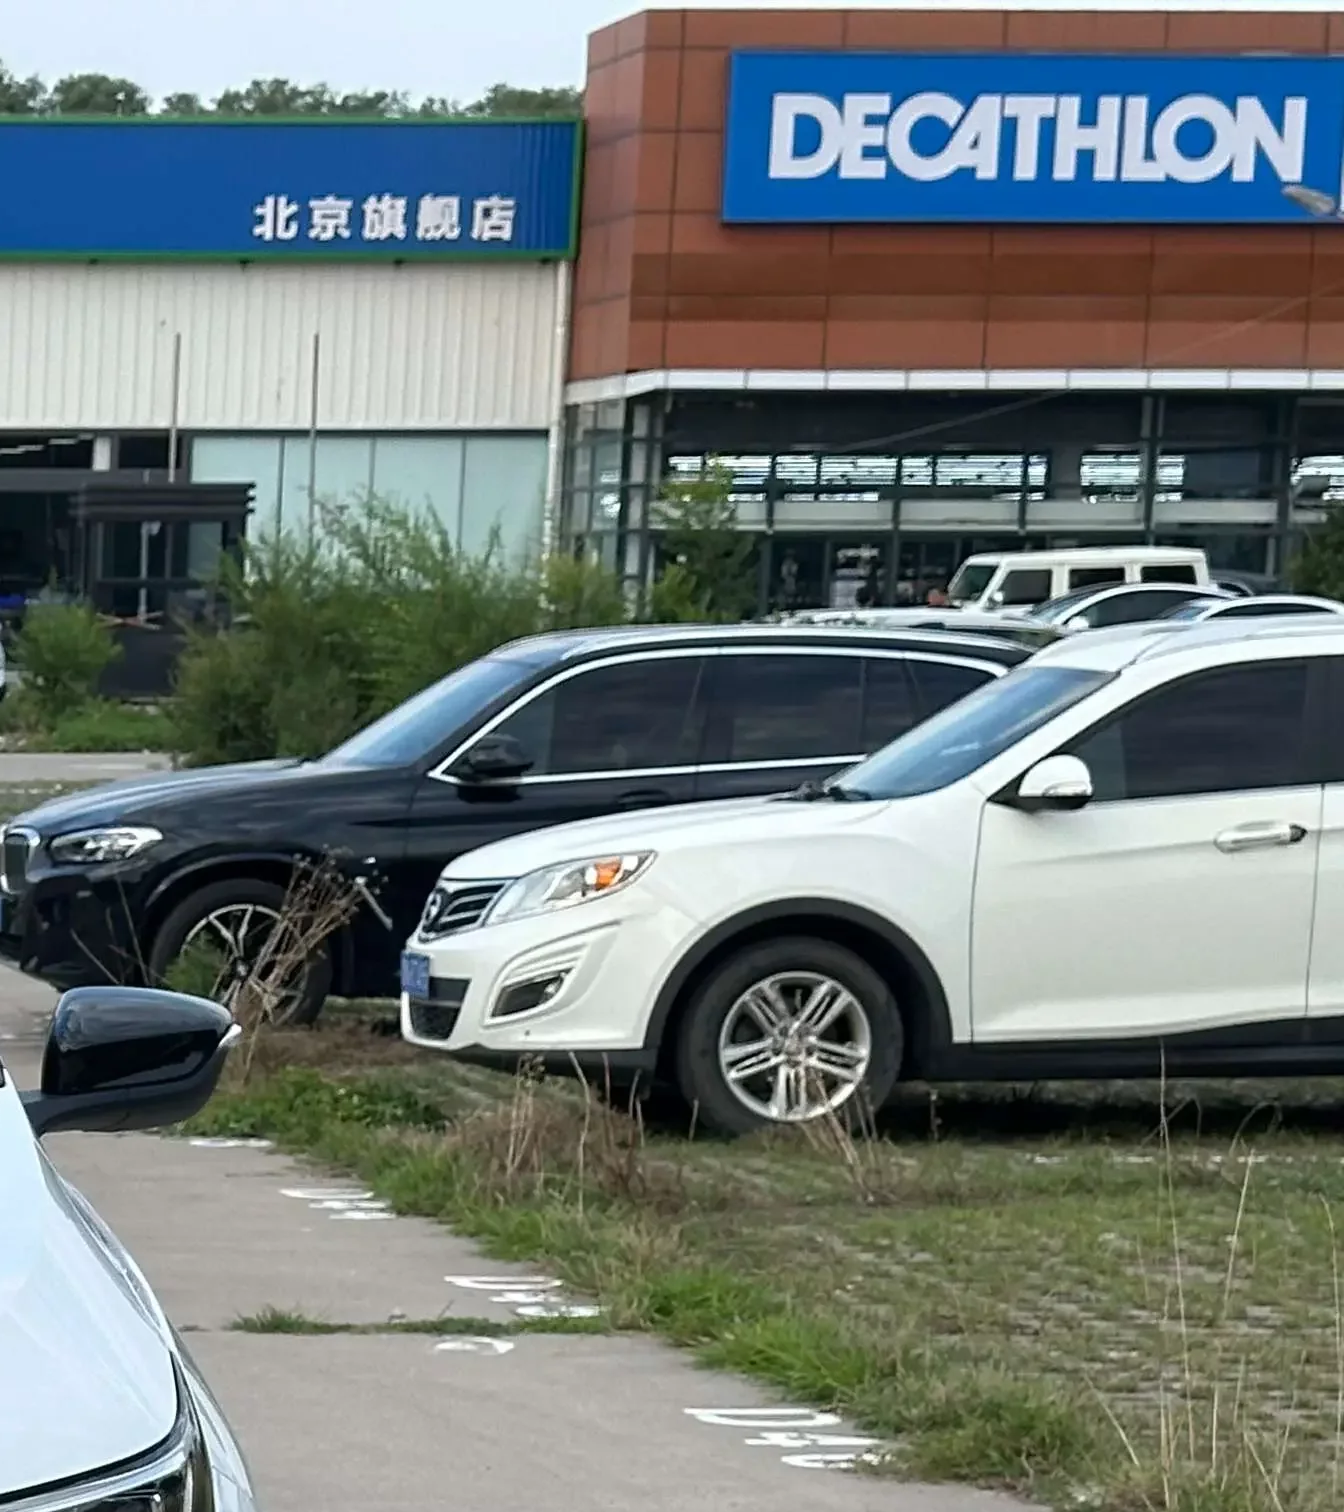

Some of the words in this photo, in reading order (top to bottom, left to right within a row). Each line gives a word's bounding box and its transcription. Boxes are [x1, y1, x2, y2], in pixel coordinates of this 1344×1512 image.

[768, 92, 1308, 183] DECATHLON
[253, 194, 515, 242] 北京旗舰店
